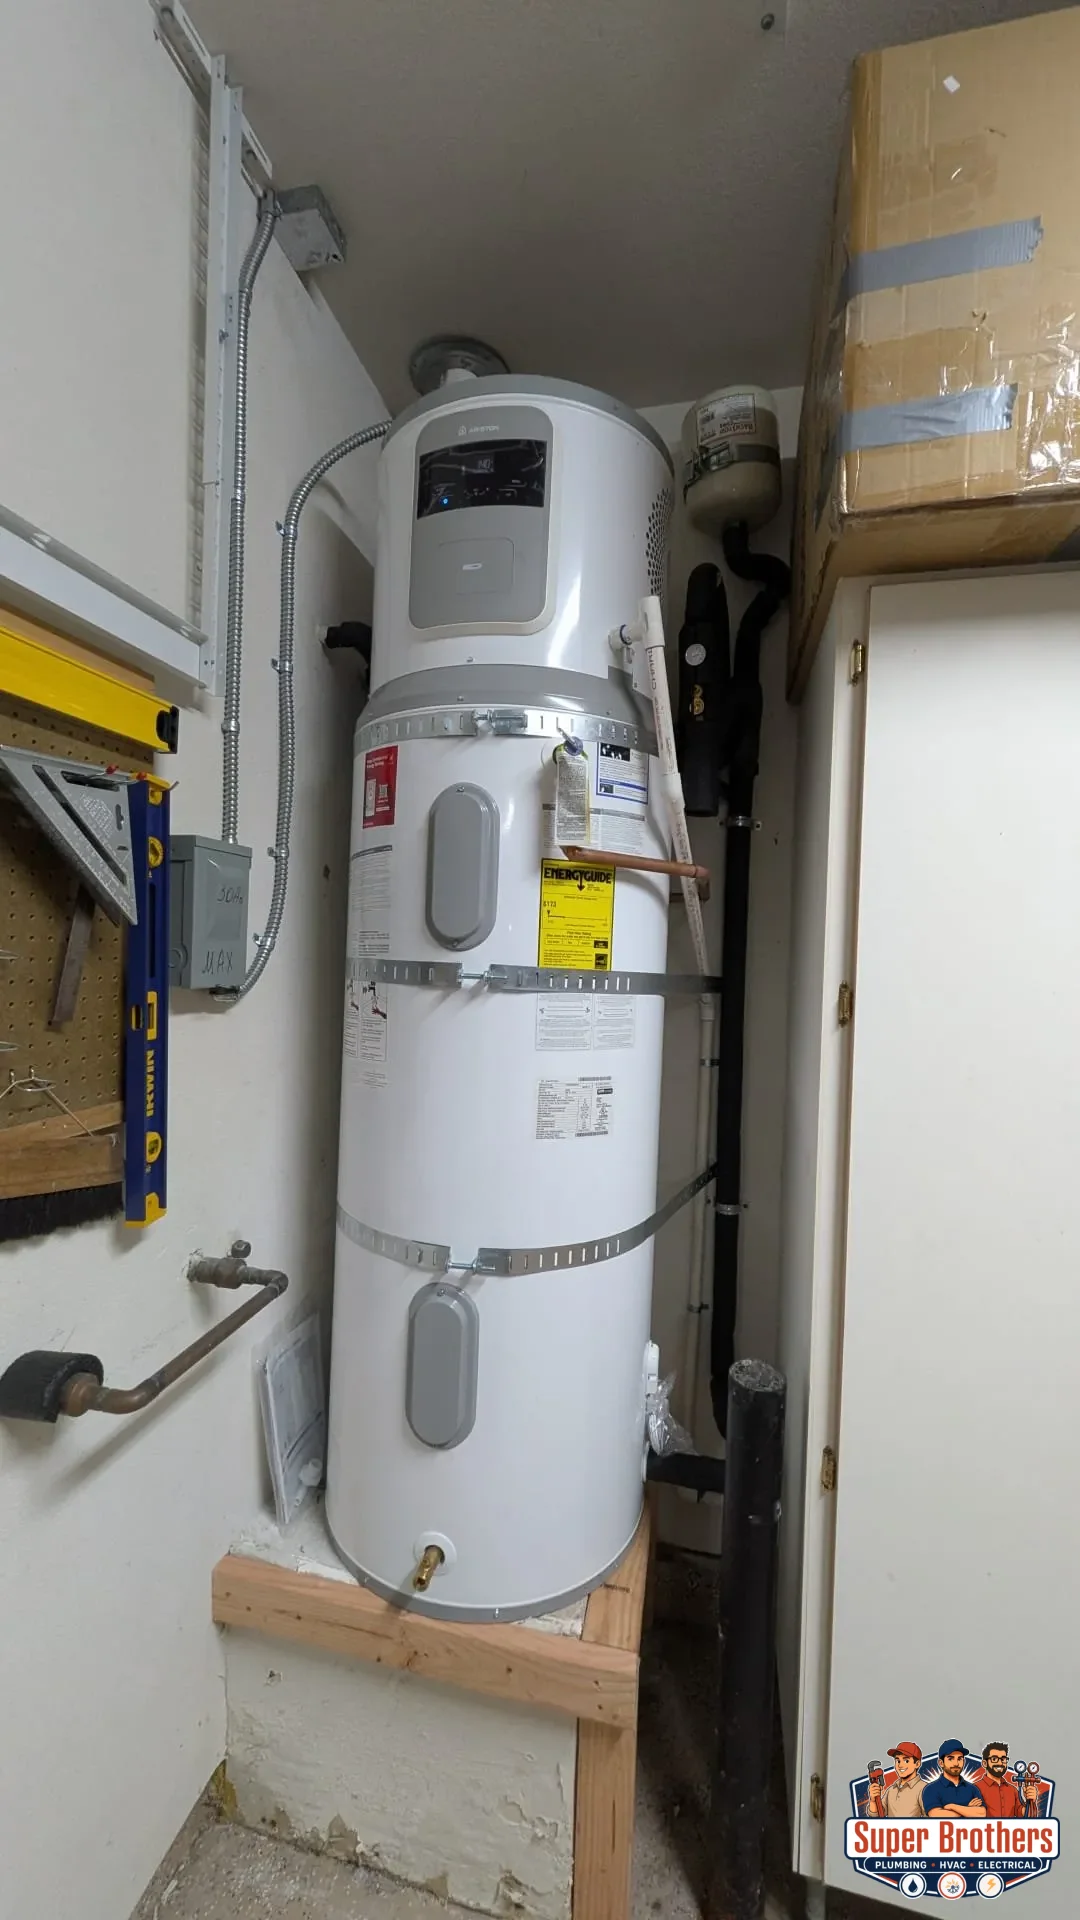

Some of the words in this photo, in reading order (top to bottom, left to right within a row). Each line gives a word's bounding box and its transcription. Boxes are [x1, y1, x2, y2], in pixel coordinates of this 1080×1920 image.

[543, 867, 612, 884] ENERGYGUIDE
[203, 948, 233, 975] MAX
[146, 1050, 155, 1117] IRWIN
